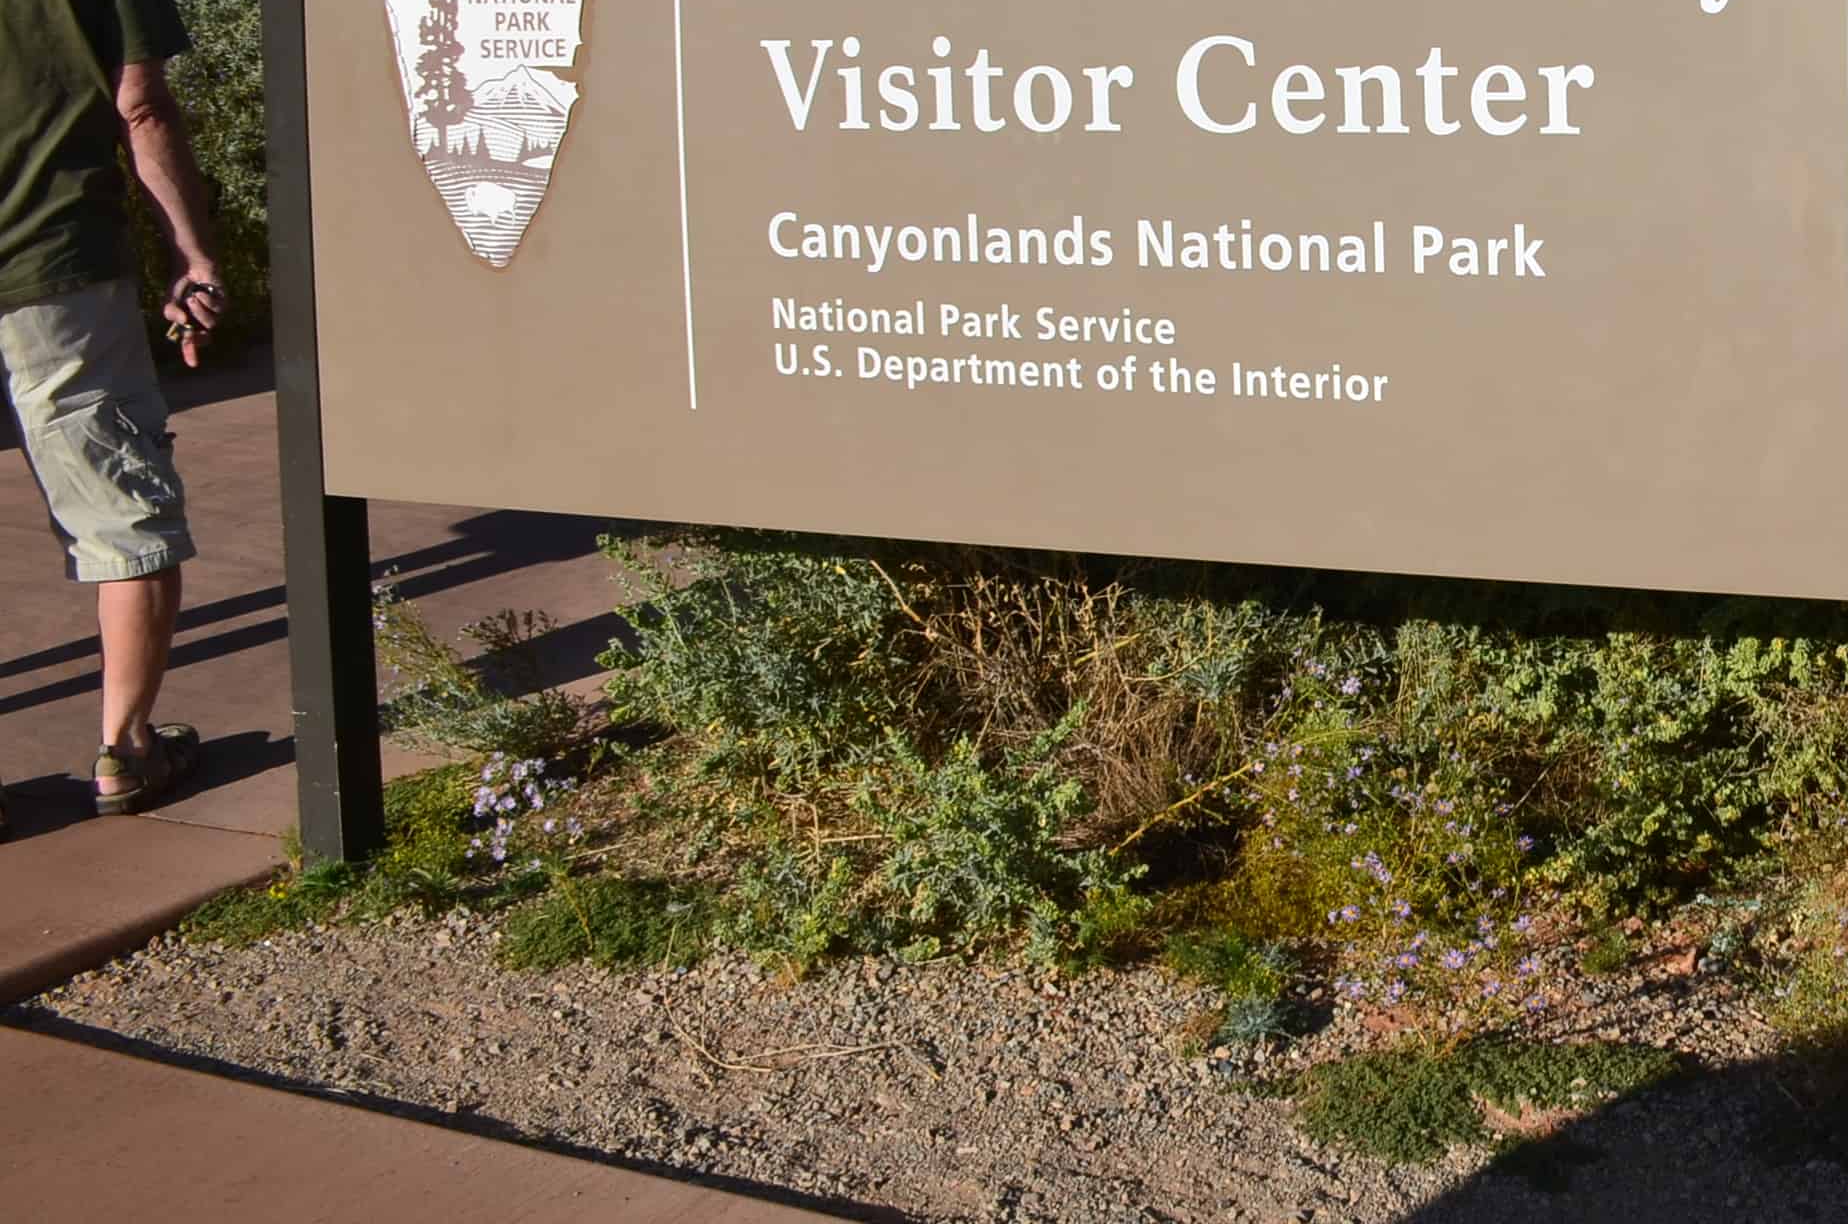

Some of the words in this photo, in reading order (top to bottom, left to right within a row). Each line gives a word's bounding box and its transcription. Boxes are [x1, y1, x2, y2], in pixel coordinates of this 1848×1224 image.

[495, 12, 551, 31] PARK
[480, 39, 567, 58] SERVICE
[759, 36, 1134, 133] Visitor
[1176, 35, 1595, 136] Center
[768, 211, 1113, 273] Canyonlands
[1137, 219, 1385, 273] National
[1413, 223, 1546, 277] Park
[772, 297, 924, 335] National
[940, 303, 1022, 339] Park
[1036, 307, 1175, 345] Service
[775, 343, 842, 377] U.S.
[857, 347, 1083, 390] Department
[1096, 355, 1137, 391] of
[1149, 357, 1216, 395] the
[1232, 362, 1388, 401] Interior
